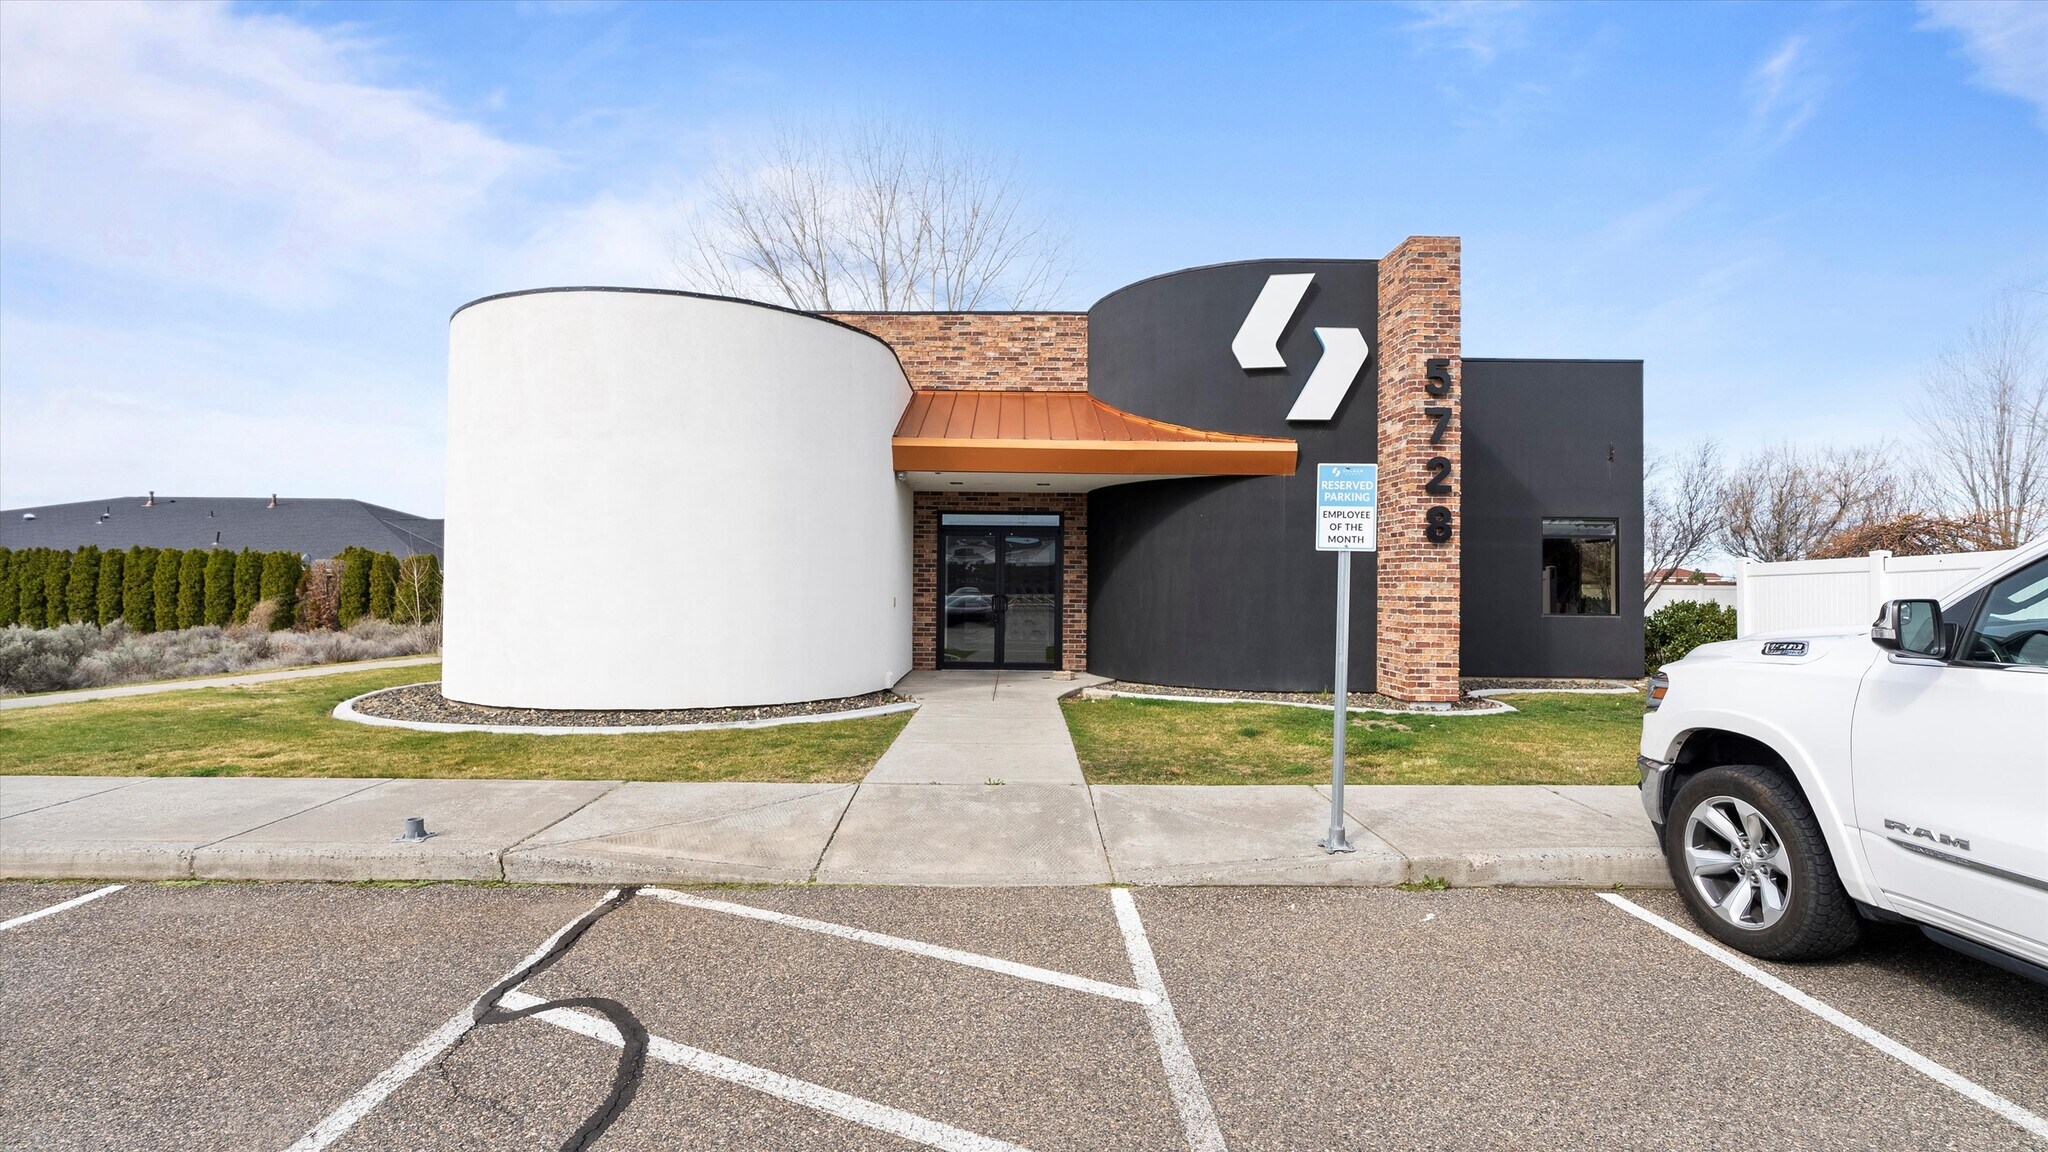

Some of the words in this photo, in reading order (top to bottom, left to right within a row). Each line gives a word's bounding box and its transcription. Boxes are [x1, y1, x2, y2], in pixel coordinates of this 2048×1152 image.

[1425, 359, 1452, 543] 5728
[1321, 481, 1374, 490] RESERVED
[1324, 492, 1370, 502] PARKING
[1322, 510, 1371, 519] EMPLOYEE
[1329, 523, 1342, 531] OF
[1345, 523, 1363, 531] THE
[1327, 535, 1364, 543] MONTH
[1884, 818, 1971, 851] RAM
